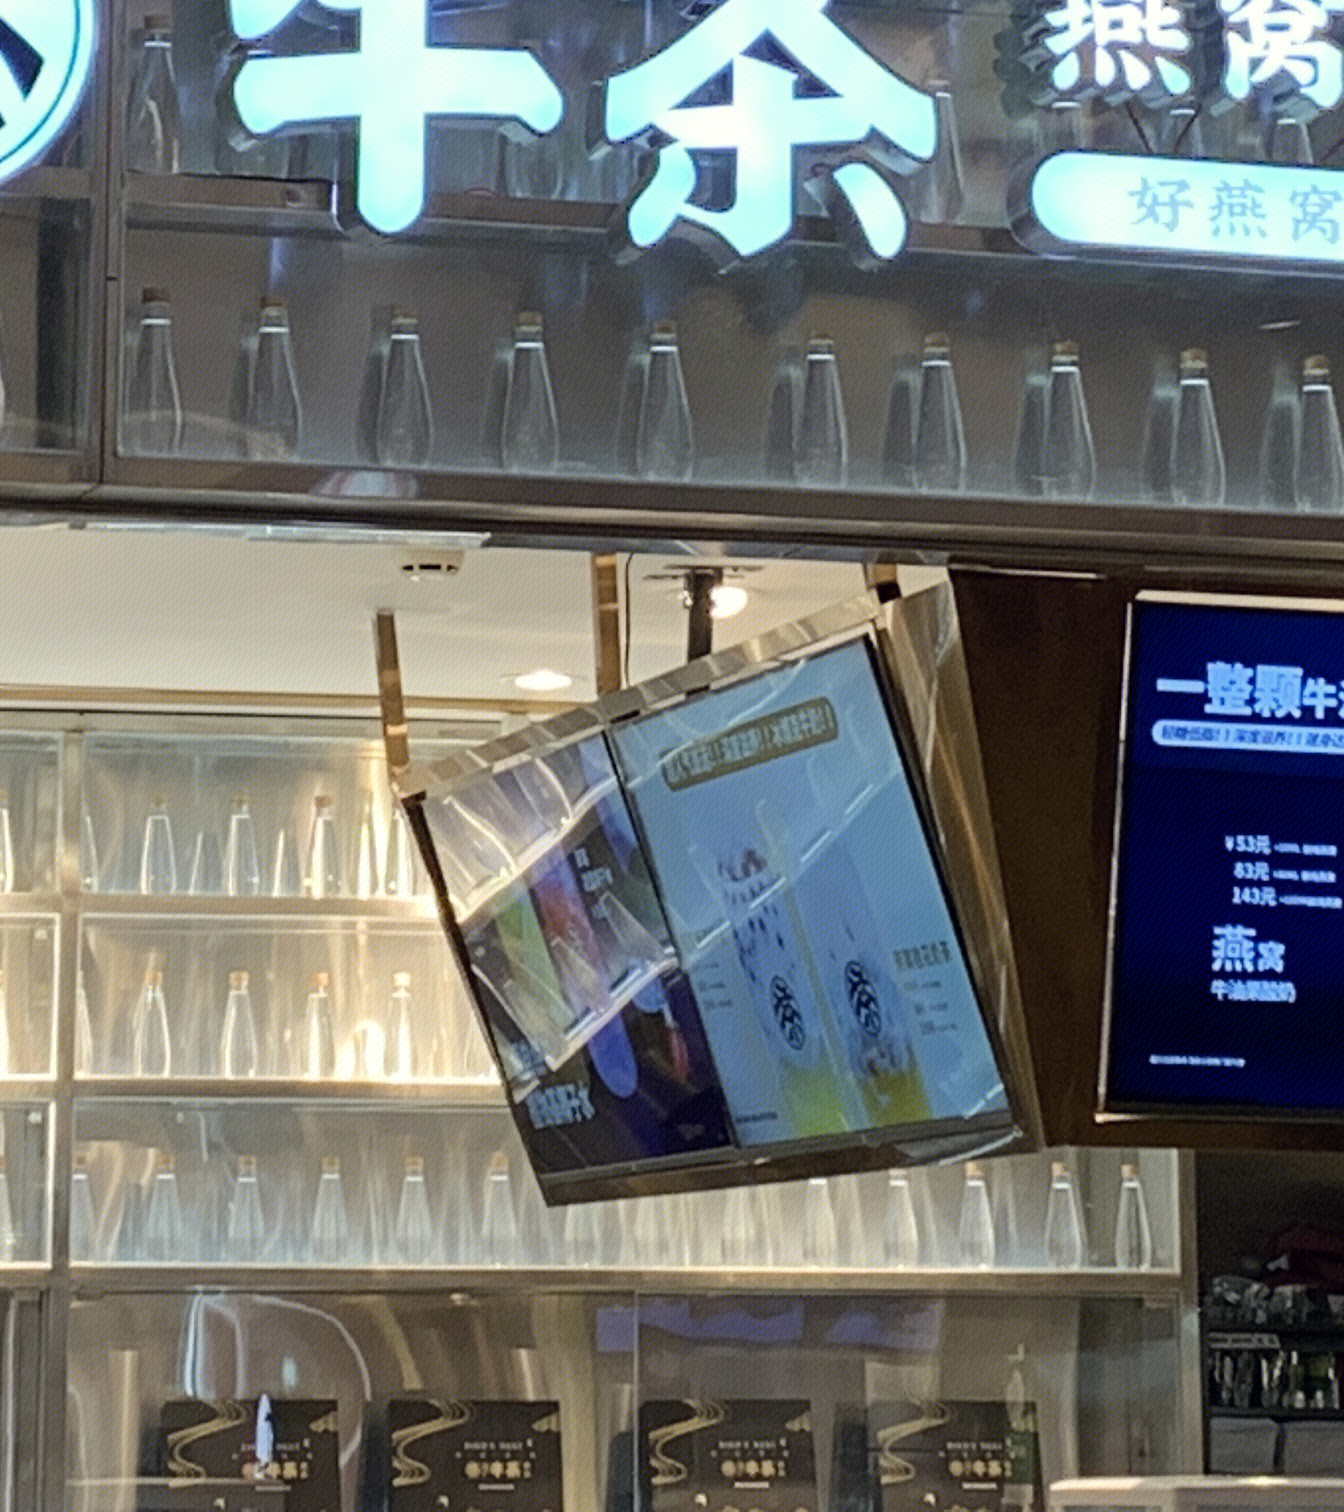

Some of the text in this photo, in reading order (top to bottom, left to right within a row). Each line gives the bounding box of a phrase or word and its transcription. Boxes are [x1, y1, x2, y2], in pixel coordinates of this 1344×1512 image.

[1128, 178, 1344, 244] 好燕窝
[1212, 924, 1285, 972] 燕窝
